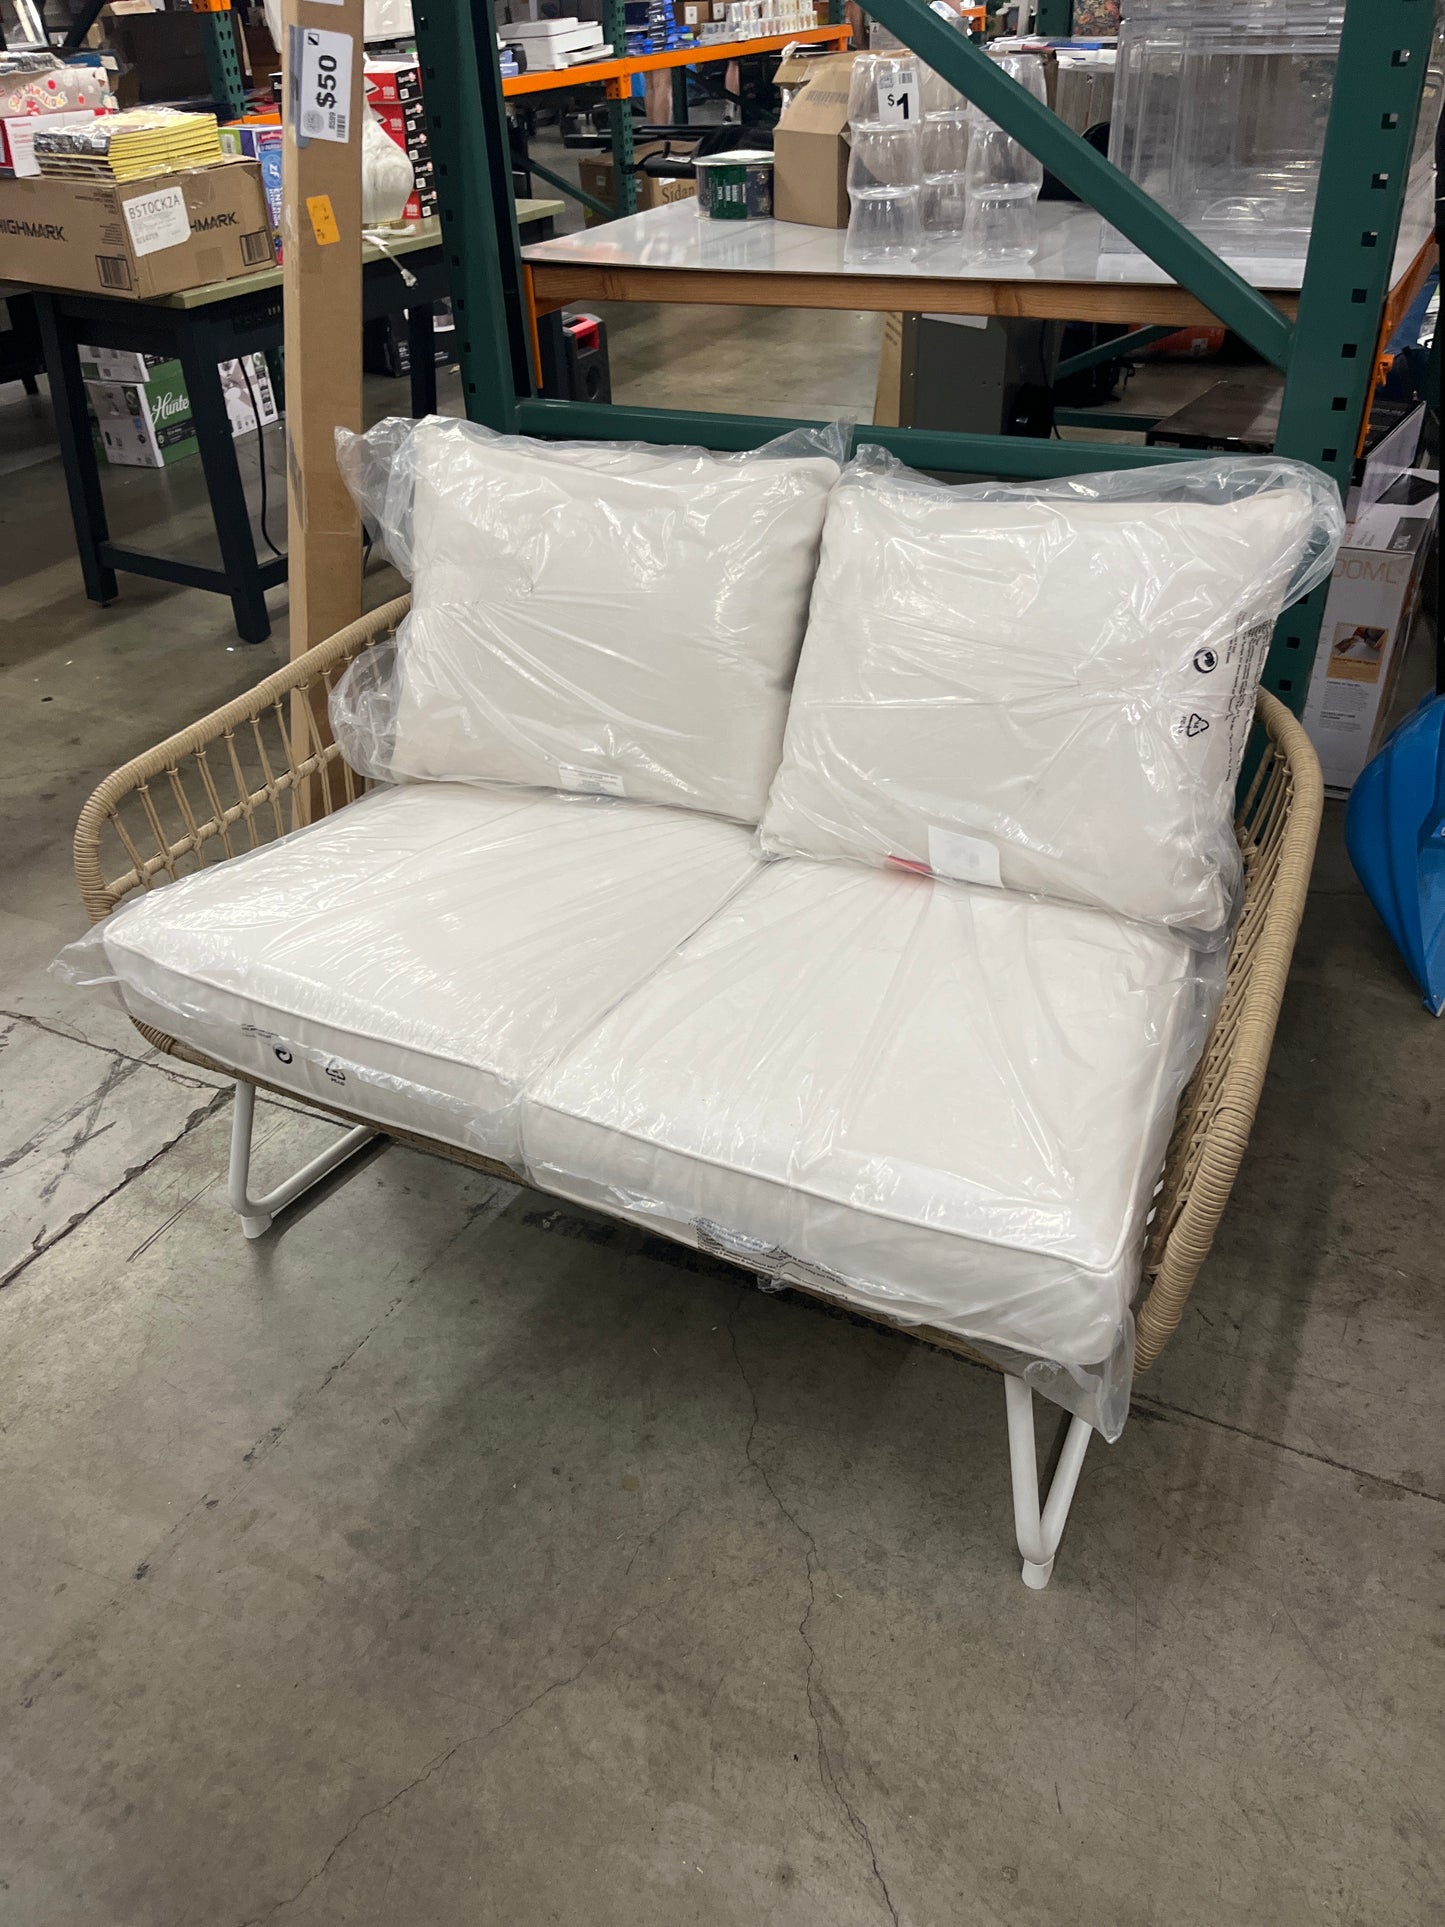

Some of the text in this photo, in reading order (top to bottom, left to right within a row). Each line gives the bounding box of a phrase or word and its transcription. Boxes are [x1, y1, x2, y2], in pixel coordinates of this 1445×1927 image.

[315, 55, 338, 109] $50
[887, 92, 909, 120] $1
[128, 194, 181, 219] BSTOCK2A
